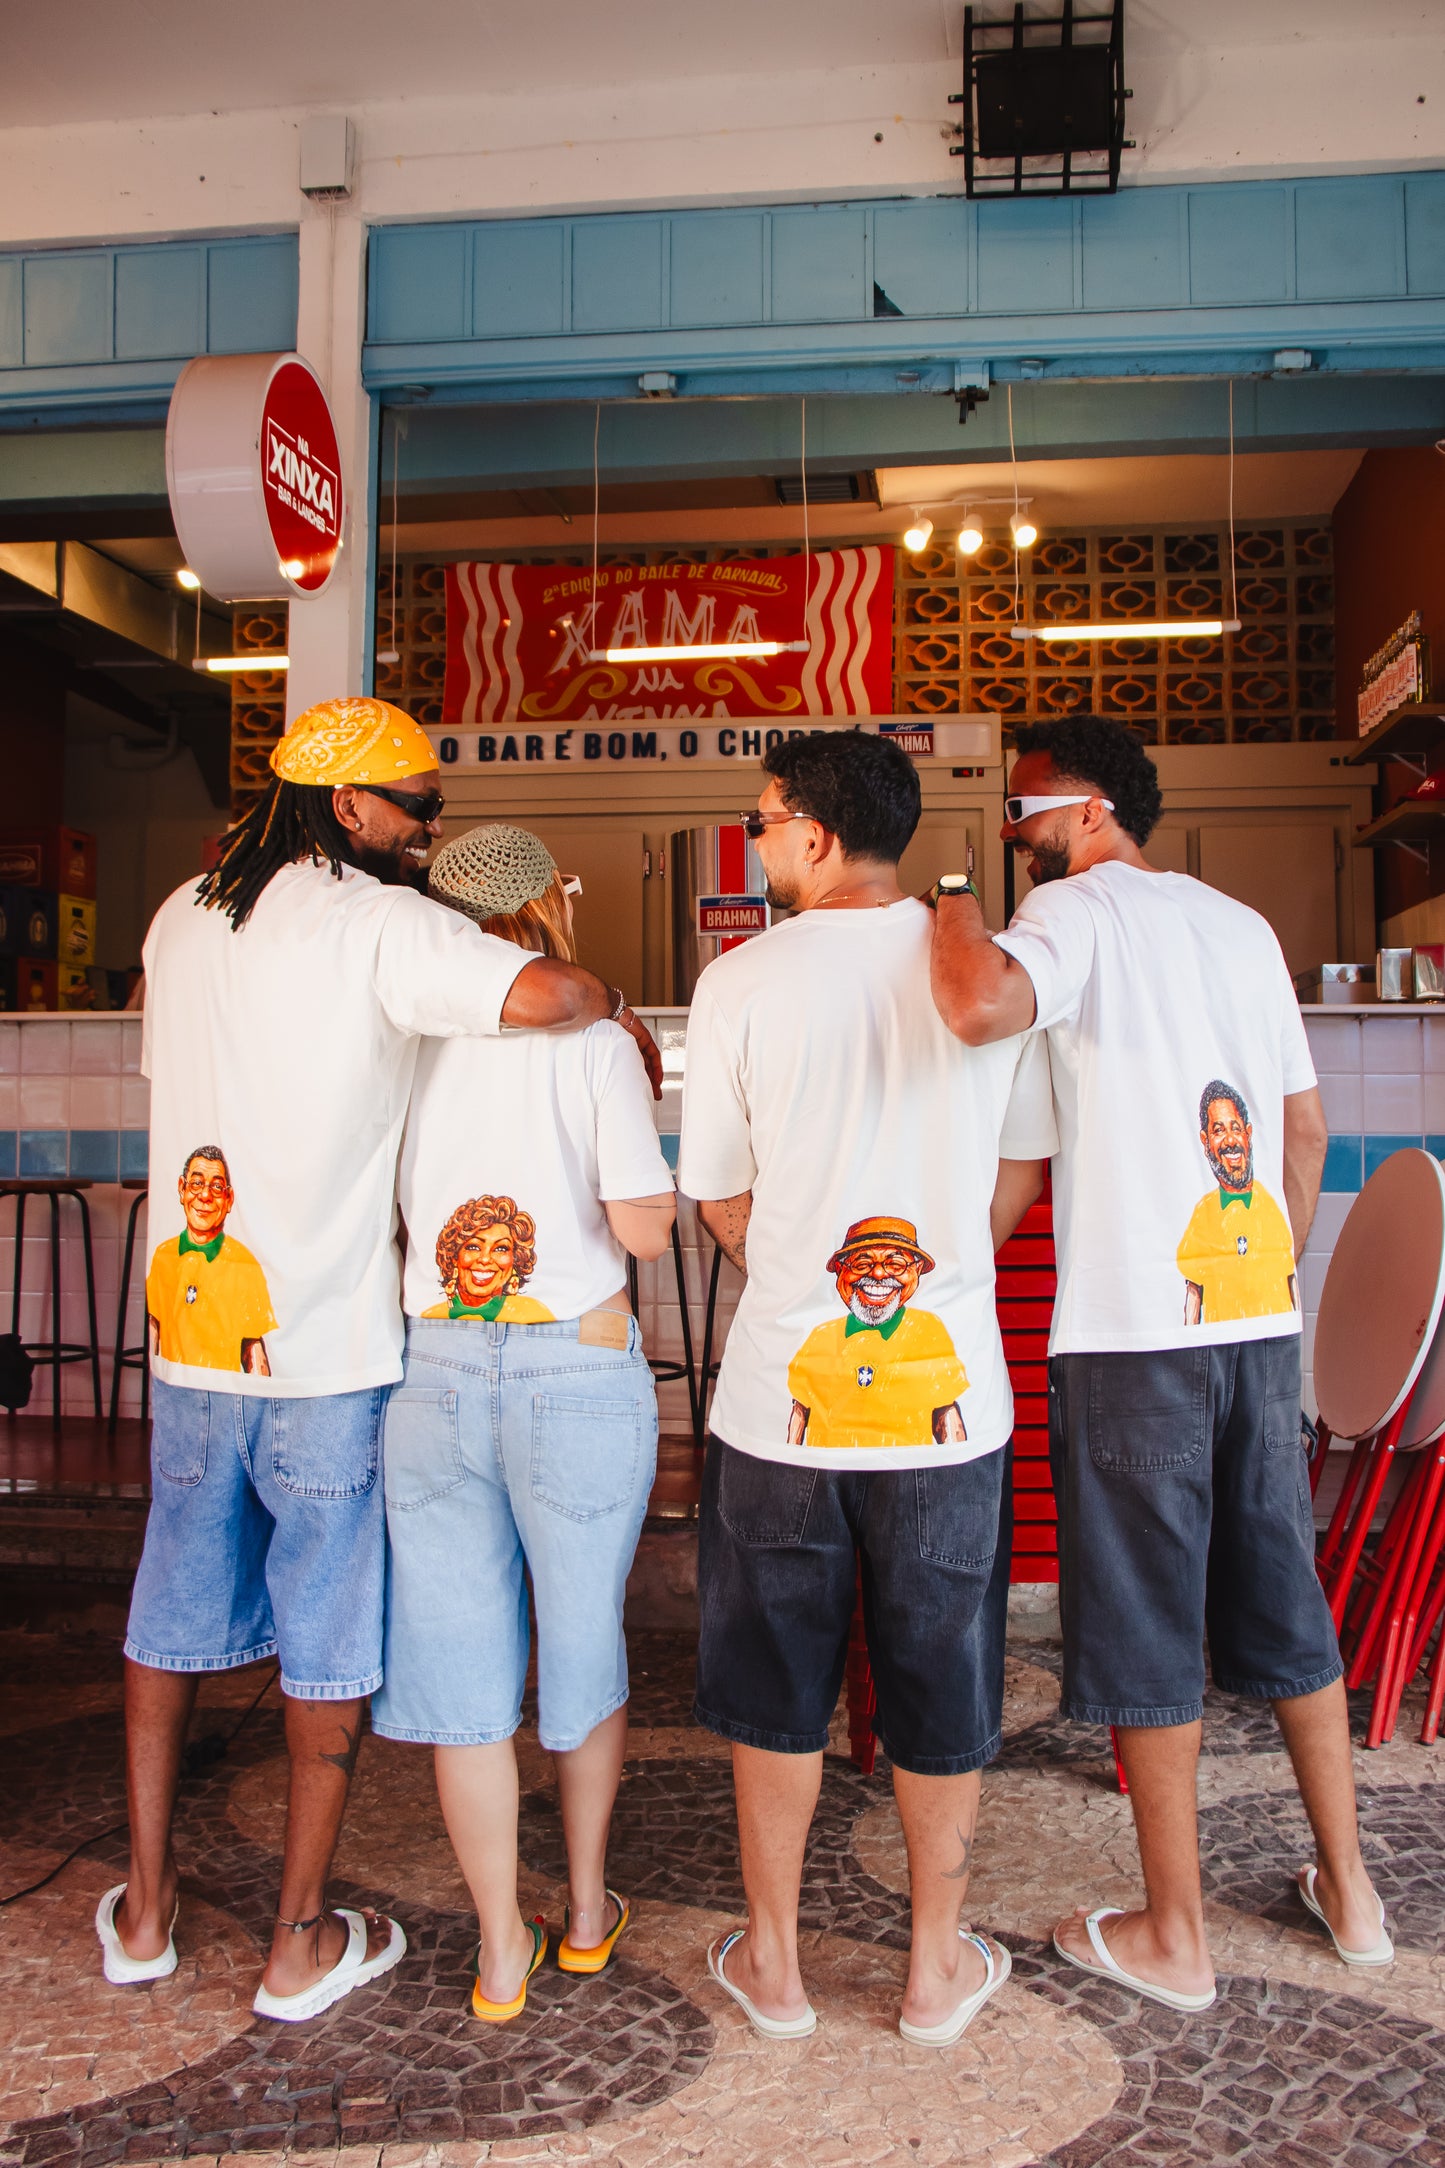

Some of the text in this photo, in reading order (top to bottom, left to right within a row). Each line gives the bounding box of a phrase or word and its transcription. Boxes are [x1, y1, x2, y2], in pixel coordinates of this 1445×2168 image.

[297, 434, 310, 459] NA
[269, 432, 334, 520] XINXA
[277, 483, 292, 508] BAR
[297, 499, 326, 533] LANCHES
[615, 568, 633, 584] DO
[638, 564, 683, 581] BAILE
[687, 564, 708, 579] DE
[712, 565, 782, 589] CARNAVAL
[544, 587, 769, 677] XAMA
[629, 666, 684, 696] NA
[440, 737, 459, 764] O
[478, 735, 544, 762] BAR
[583, 731, 667, 762] BOM,
[680, 730, 698, 758] O
[718, 729, 826, 757] CHO
[881, 735, 931, 752] AHMA
[706, 909, 760, 927] BRAHMA
